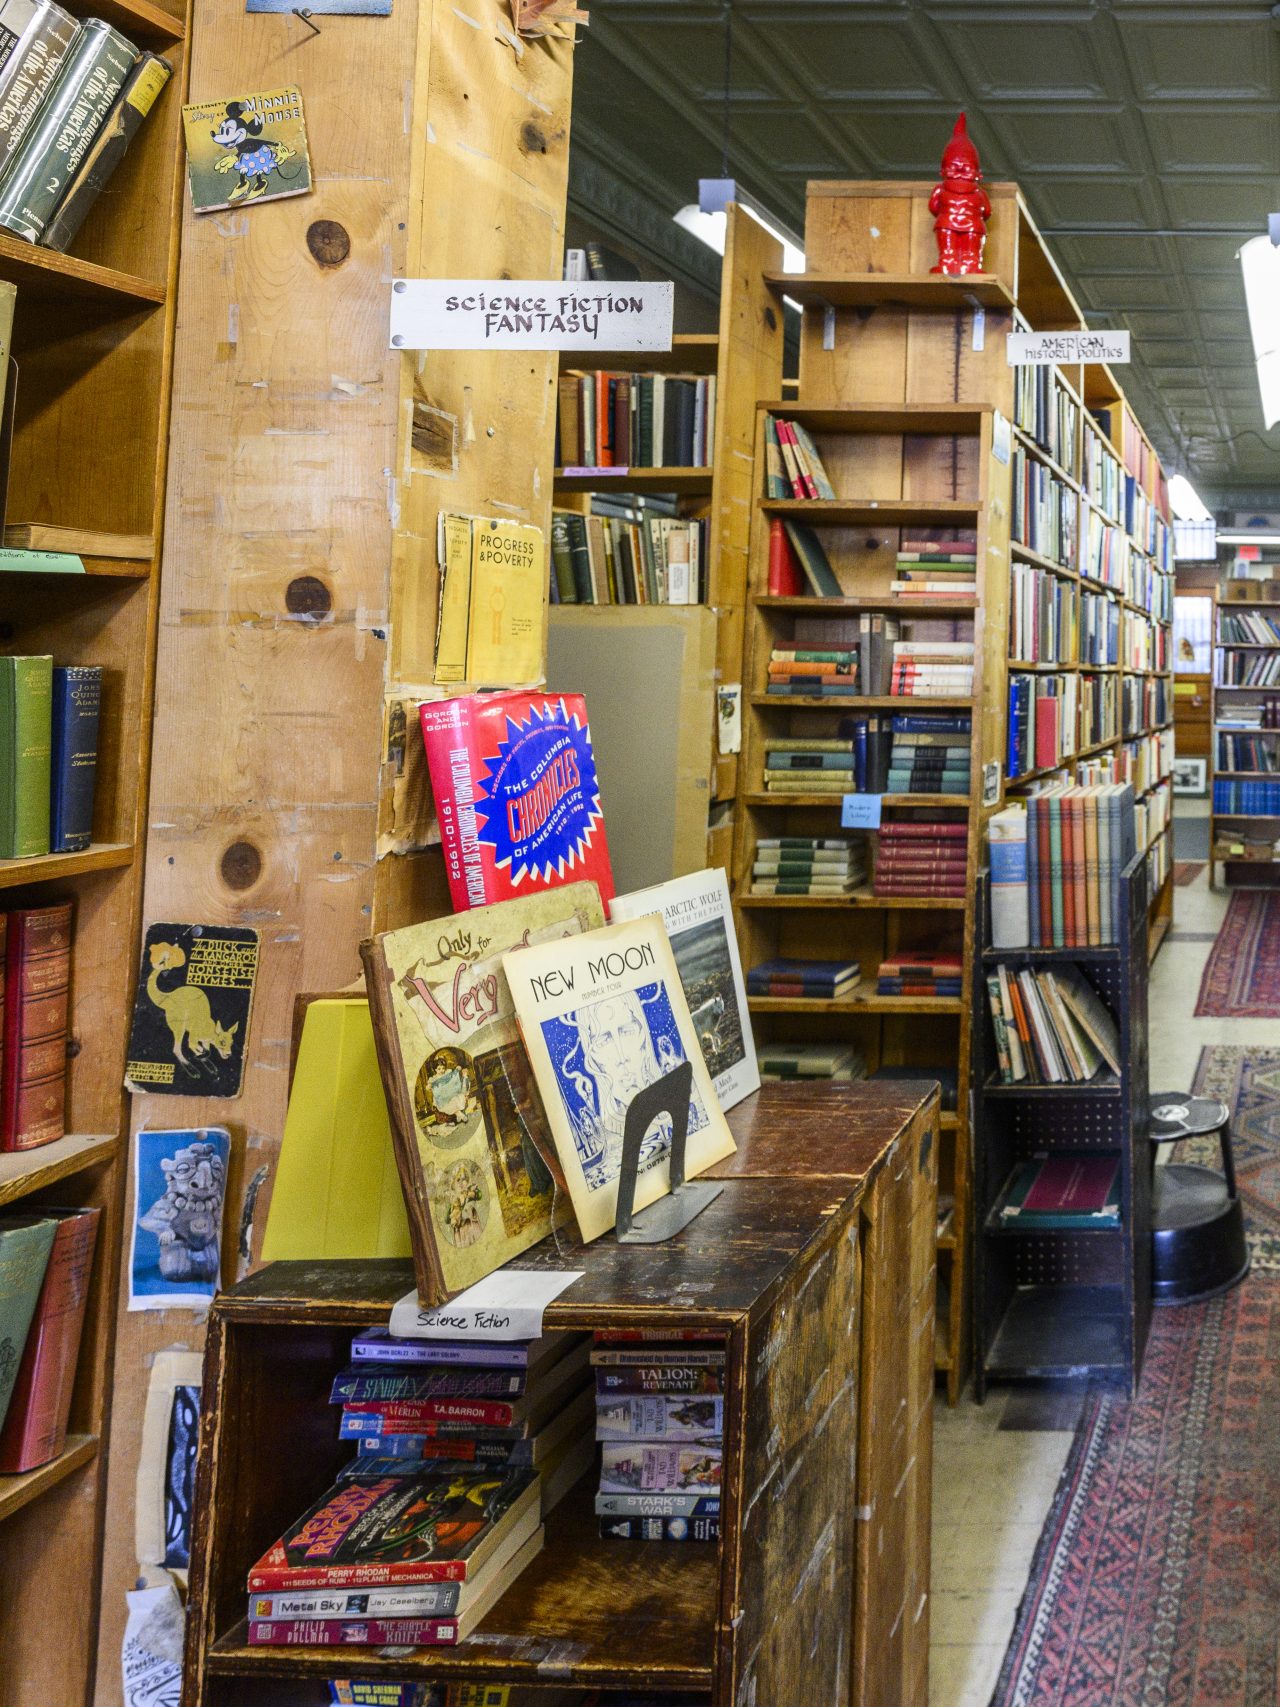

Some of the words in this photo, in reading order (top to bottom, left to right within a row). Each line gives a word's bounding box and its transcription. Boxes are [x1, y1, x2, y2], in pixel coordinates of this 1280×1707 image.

[94, 66, 108, 78] of
[85, 79, 104, 103] the
[101, 77, 122, 109] Native
[201, 101, 227, 110] DISNEY'S
[245, 90, 298, 113] MINNIE
[190, 110, 215, 124] Story
[254, 107, 301, 127] MOUSE
[55, 99, 90, 154] Americas
[66, 106, 105, 174] Languages
[46, 176, 61, 195] 2
[445, 292, 547, 313] SCIENCE
[556, 292, 645, 315] FICTION
[485, 312, 600, 340] FANTASY
[1041, 336, 1105, 349] AMERICAN
[1025, 347, 1071, 362] HISTORY
[1077, 346, 1124, 361] POLITICS
[480, 534, 534, 555] PROGRESS
[479, 551, 534, 569] &POVERTY
[425, 708, 468, 719] GORDON
[436, 715, 460, 724] AND
[426, 721, 470, 732] GORDON
[450, 747, 470, 763] THE
[504, 779, 529, 795] THE
[530, 736, 571, 781] COLUMBIA
[452, 760, 474, 806] COLUMBIA
[506, 748, 581, 843] CHRONICLES
[457, 803, 481, 853] CHRONICLES
[514, 845, 529, 858] OF
[531, 803, 567, 849] AMERICAN
[567, 790, 583, 806] LIFE
[555, 816, 569, 836] 1910
[570, 803, 585, 815] 1992
[441, 798, 460, 880] 1910-1992
[464, 849, 481, 863] OF
[465, 861, 487, 906] AMERICAN
[664, 897, 698, 919] ARCTIC
[699, 889, 723, 906] WOLF
[672, 915, 690, 928] WITH
[692, 911, 707, 922] THE
[207, 941, 238, 951] DUCK
[437, 928, 472, 962] Only
[476, 935, 493, 953] for
[189, 964, 255, 977] NONSENSE
[530, 966, 576, 1004] NEW
[587, 942, 656, 988] MOON
[405, 962, 498, 1034] Very
[417, 1312, 469, 1330] Science
[474, 1311, 511, 1329] Fiction
[638, 1368, 699, 1381] TALION:
[643, 1380, 696, 1390] REVENANT
[434, 1405, 448, 1415] T.A.
[449, 1406, 485, 1418] BARRON
[627, 1496, 687, 1507] STARK'S
[640, 1505, 673, 1516] WAR
[328, 1569, 354, 1578] PERRY
[356, 1567, 390, 1577] RHODAN
[281, 1602, 318, 1612] Metal
[320, 1600, 344, 1612] Sky
[370, 1598, 387, 1608] Jay
[293, 1621, 326, 1633] PHILIP
[376, 1621, 396, 1633] THE
[397, 1620, 432, 1632] SUBTLE
[287, 1631, 330, 1644] PULLMAN
[386, 1631, 421, 1644] KNIFE
